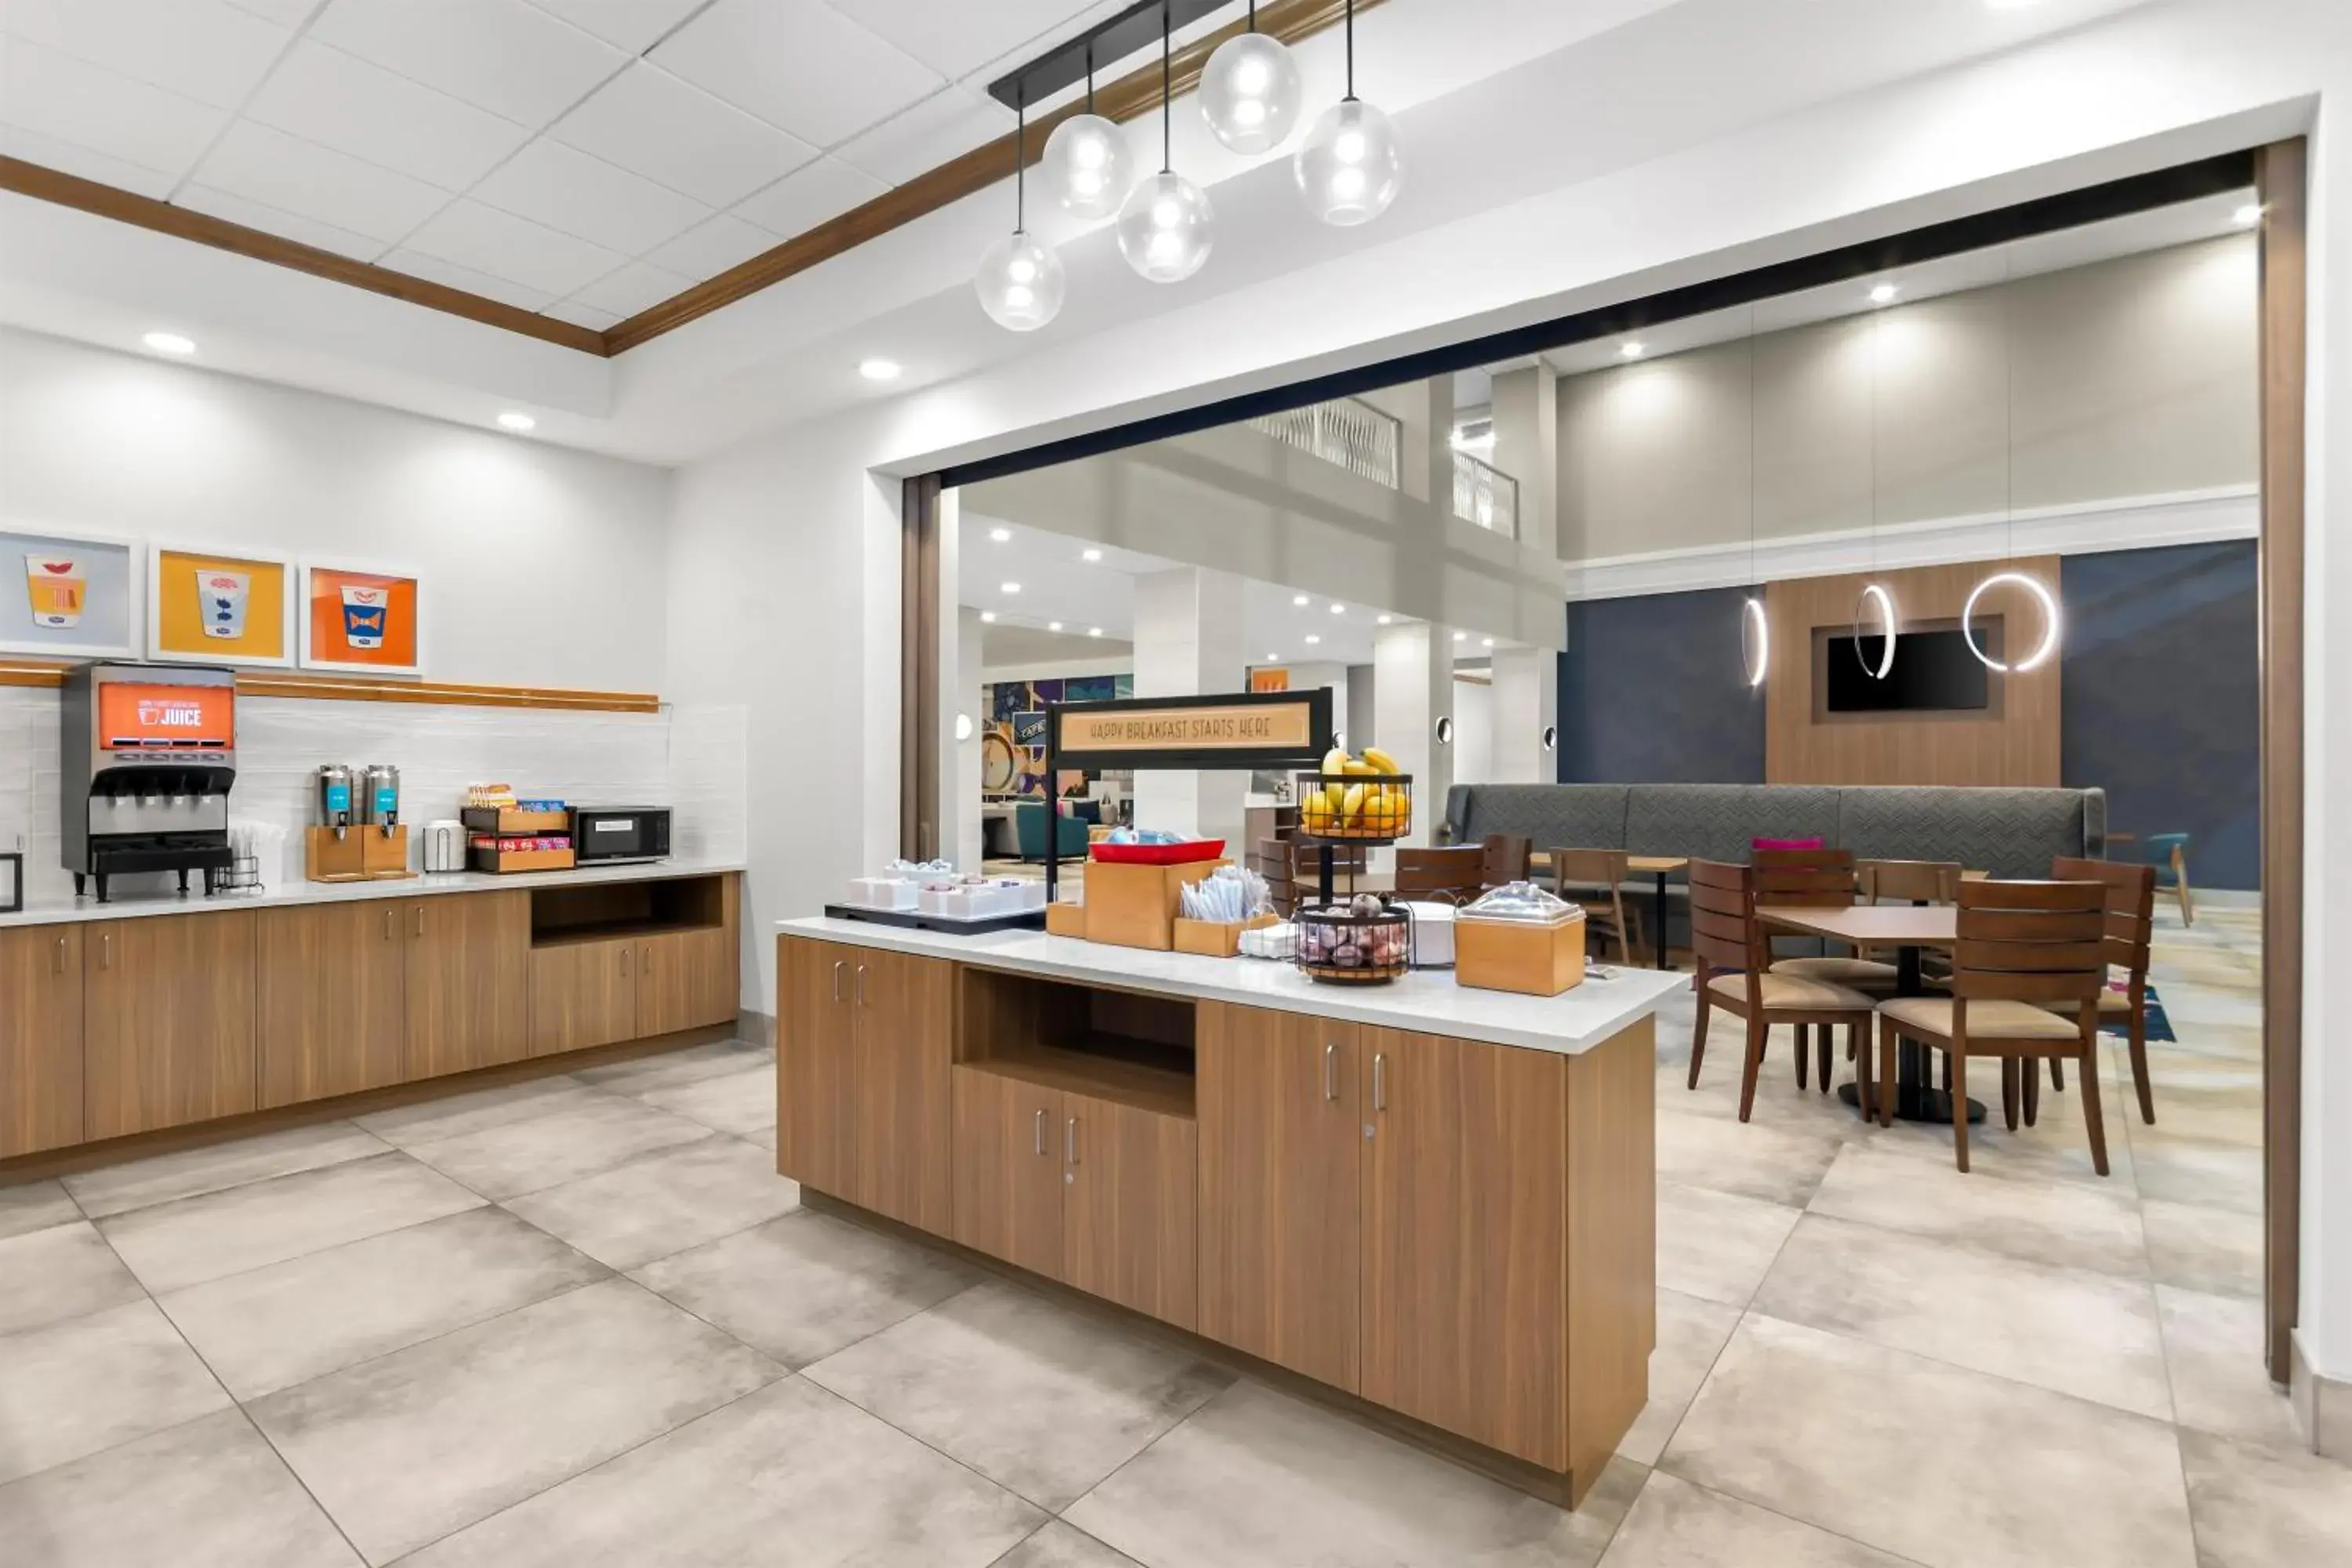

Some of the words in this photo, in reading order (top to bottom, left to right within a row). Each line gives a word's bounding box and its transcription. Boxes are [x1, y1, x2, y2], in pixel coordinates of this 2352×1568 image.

[160, 708, 201, 727] JUICE
[1091, 720, 1123, 739] HAPPY
[1127, 720, 1188, 740] BREAKFAST
[1192, 718, 1234, 739] STARTS
[1239, 717, 1271, 737] HERE
